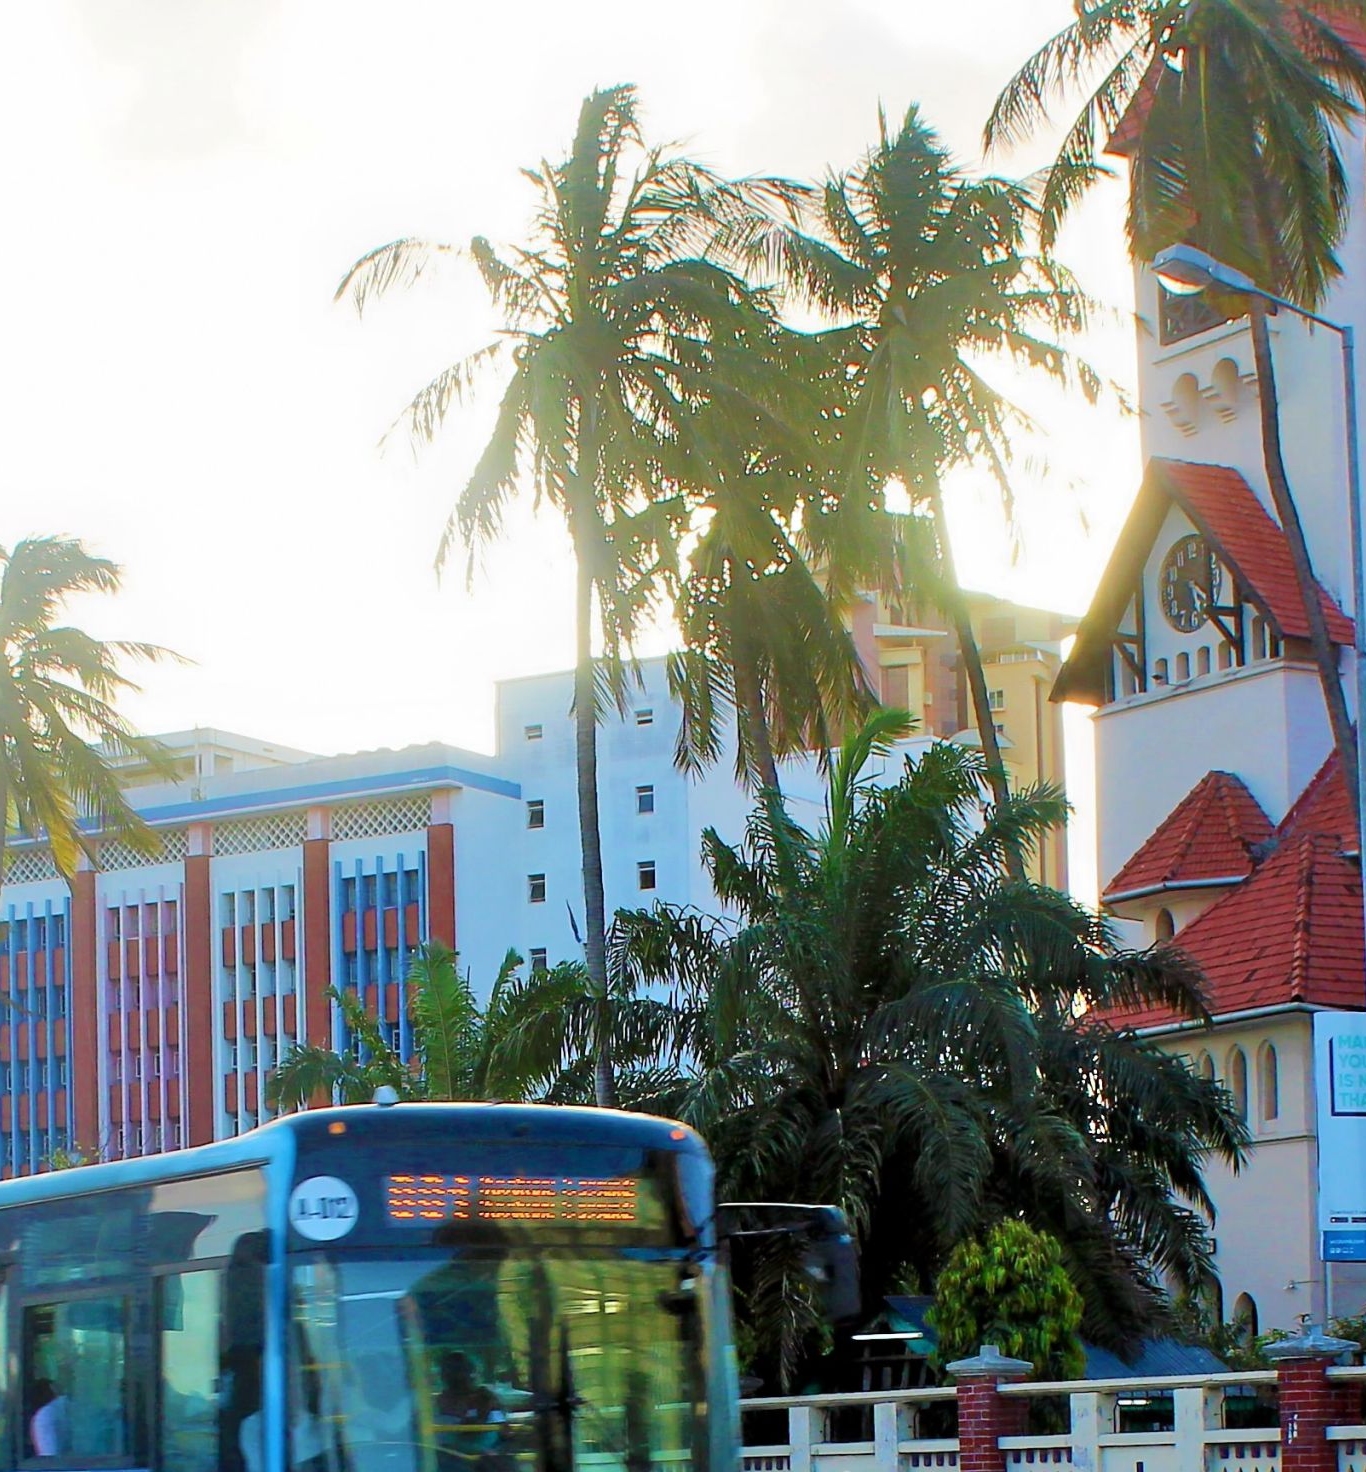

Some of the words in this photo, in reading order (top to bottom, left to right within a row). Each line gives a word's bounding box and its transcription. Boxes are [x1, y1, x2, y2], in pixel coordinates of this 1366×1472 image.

[1179, 610, 1186, 626] 7
[1191, 611, 1198, 627] 6
[1339, 1074, 1353, 1087] IS
